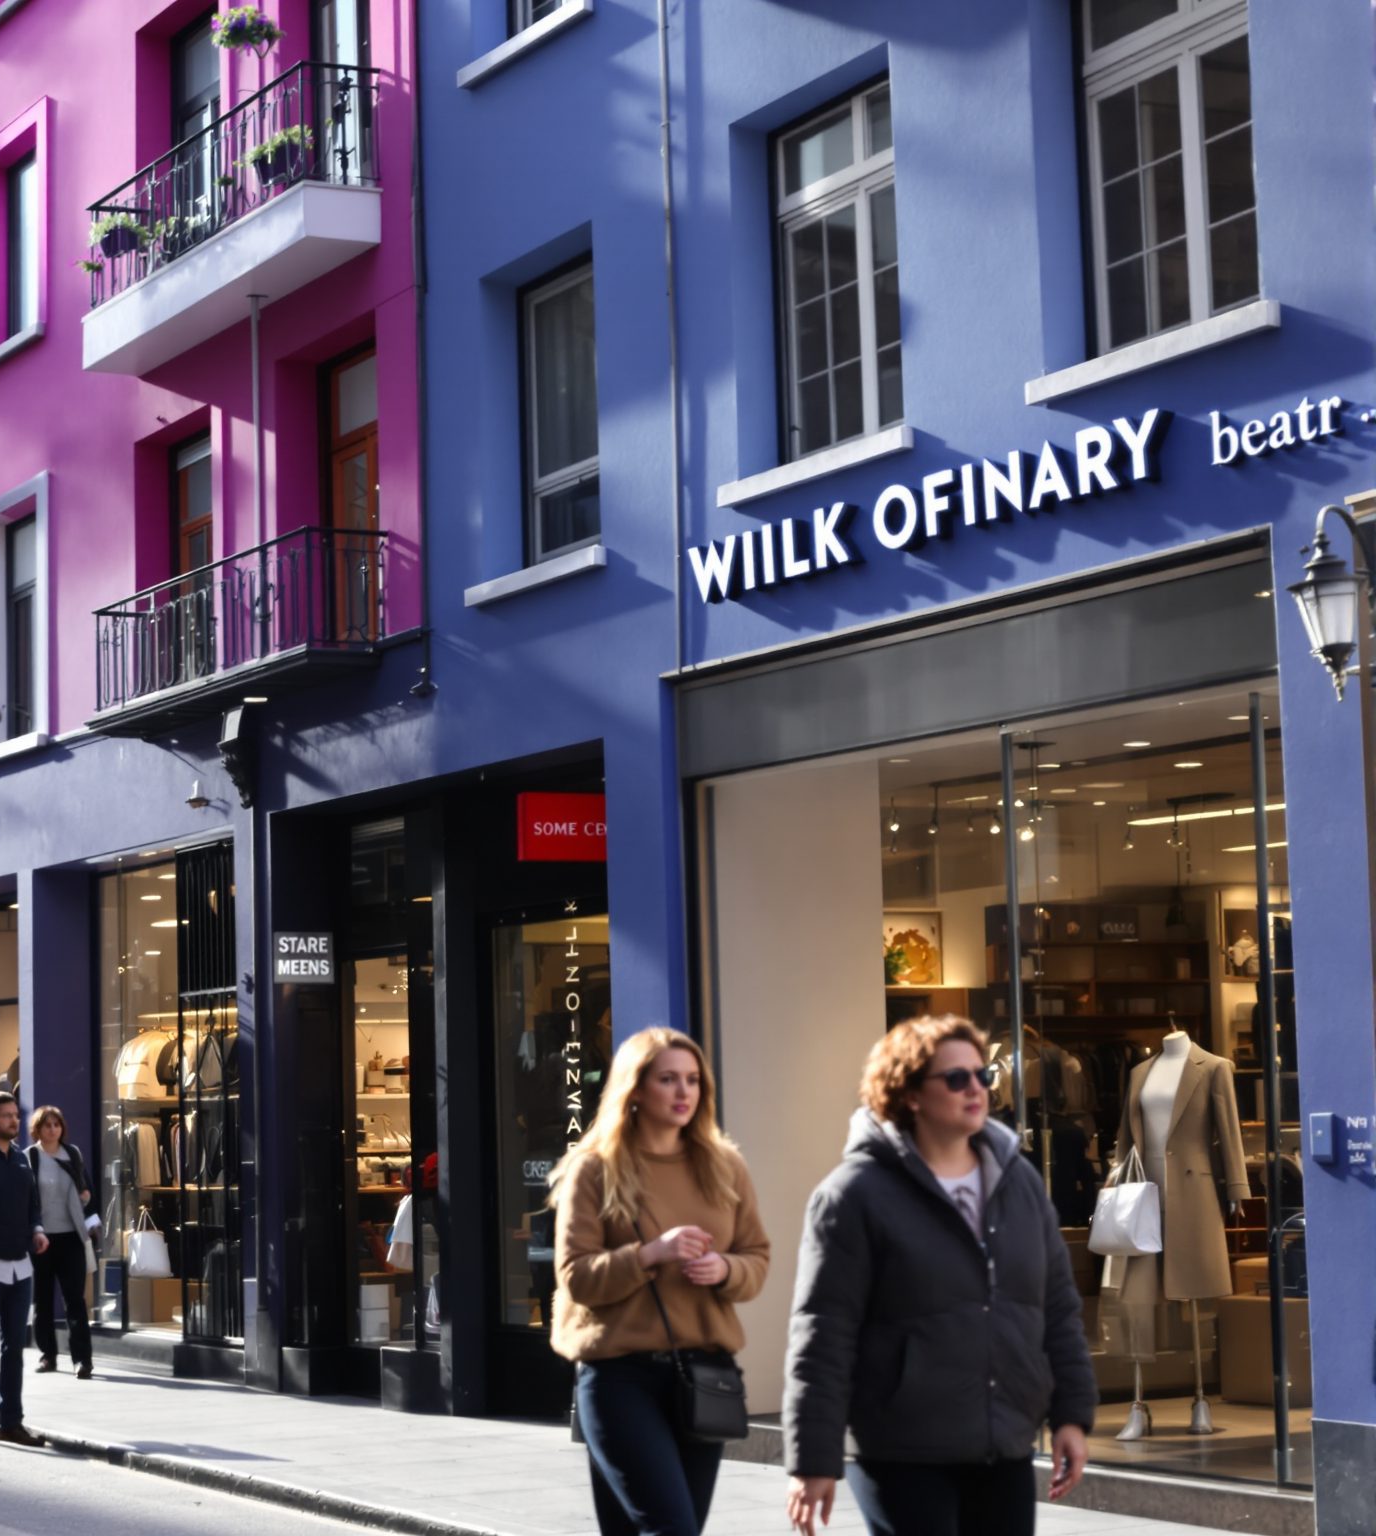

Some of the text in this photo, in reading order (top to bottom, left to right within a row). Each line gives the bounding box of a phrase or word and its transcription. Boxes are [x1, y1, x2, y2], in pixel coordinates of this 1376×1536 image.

[1208, 395, 1342, 466] beatr
[687, 407, 1160, 604] WIILK OFINARY
[533, 822, 607, 837] SOME CE
[278, 935, 329, 954] STARE
[277, 958, 330, 976] MEENS
